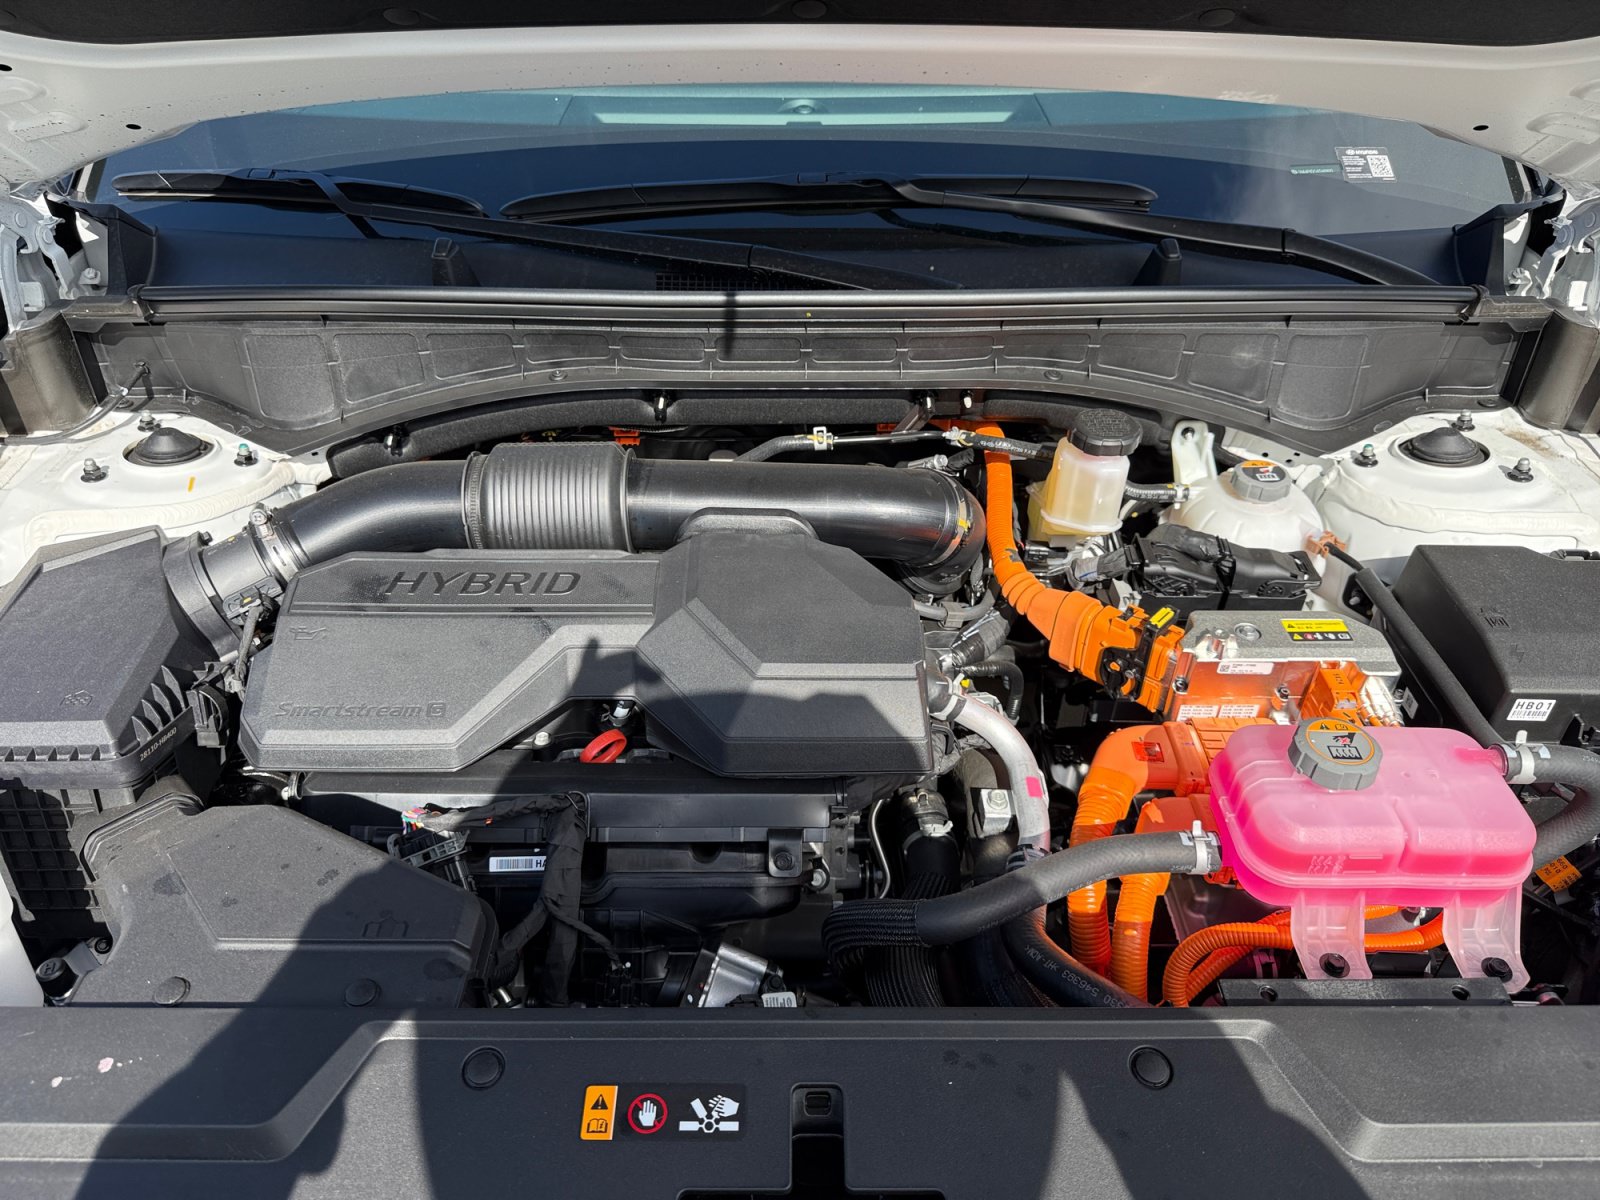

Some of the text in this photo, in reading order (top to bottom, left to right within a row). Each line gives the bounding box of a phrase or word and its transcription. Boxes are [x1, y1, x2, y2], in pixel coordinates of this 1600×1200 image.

[385, 571, 581, 596] HYBRID
[275, 702, 446, 718] Smartstream G
[1515, 701, 1552, 711] HB01
[1061, 969, 1100, 997] 546393
